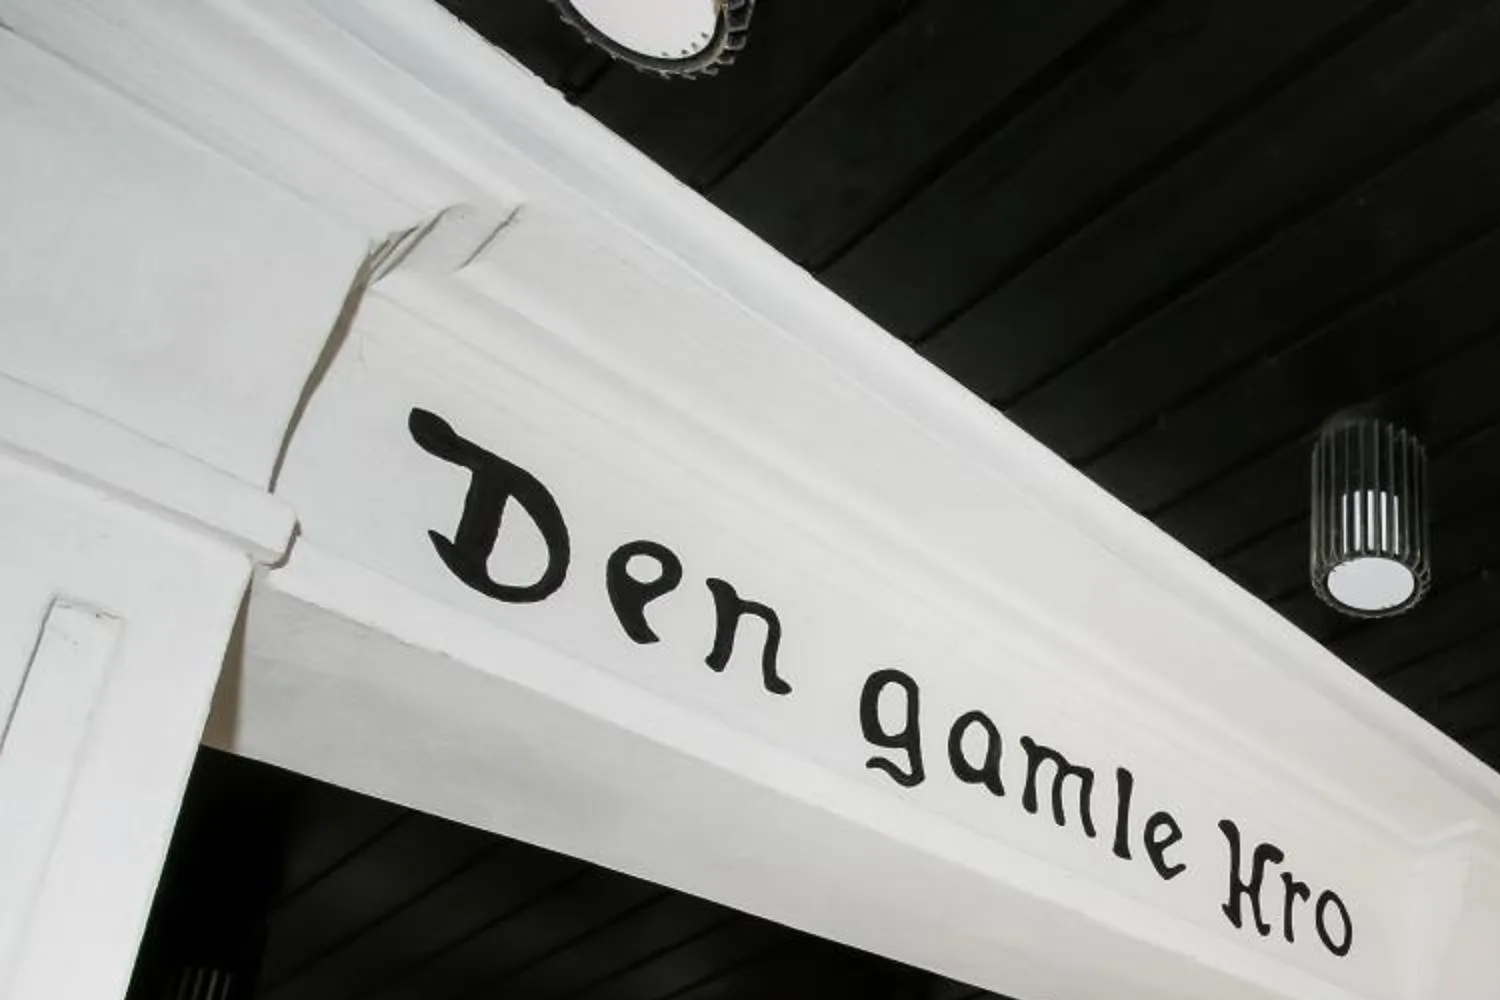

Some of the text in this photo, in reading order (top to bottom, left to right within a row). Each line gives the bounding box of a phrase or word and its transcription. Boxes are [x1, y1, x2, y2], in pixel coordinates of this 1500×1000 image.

[408, 407, 1353, 957] Den gamle Kro
